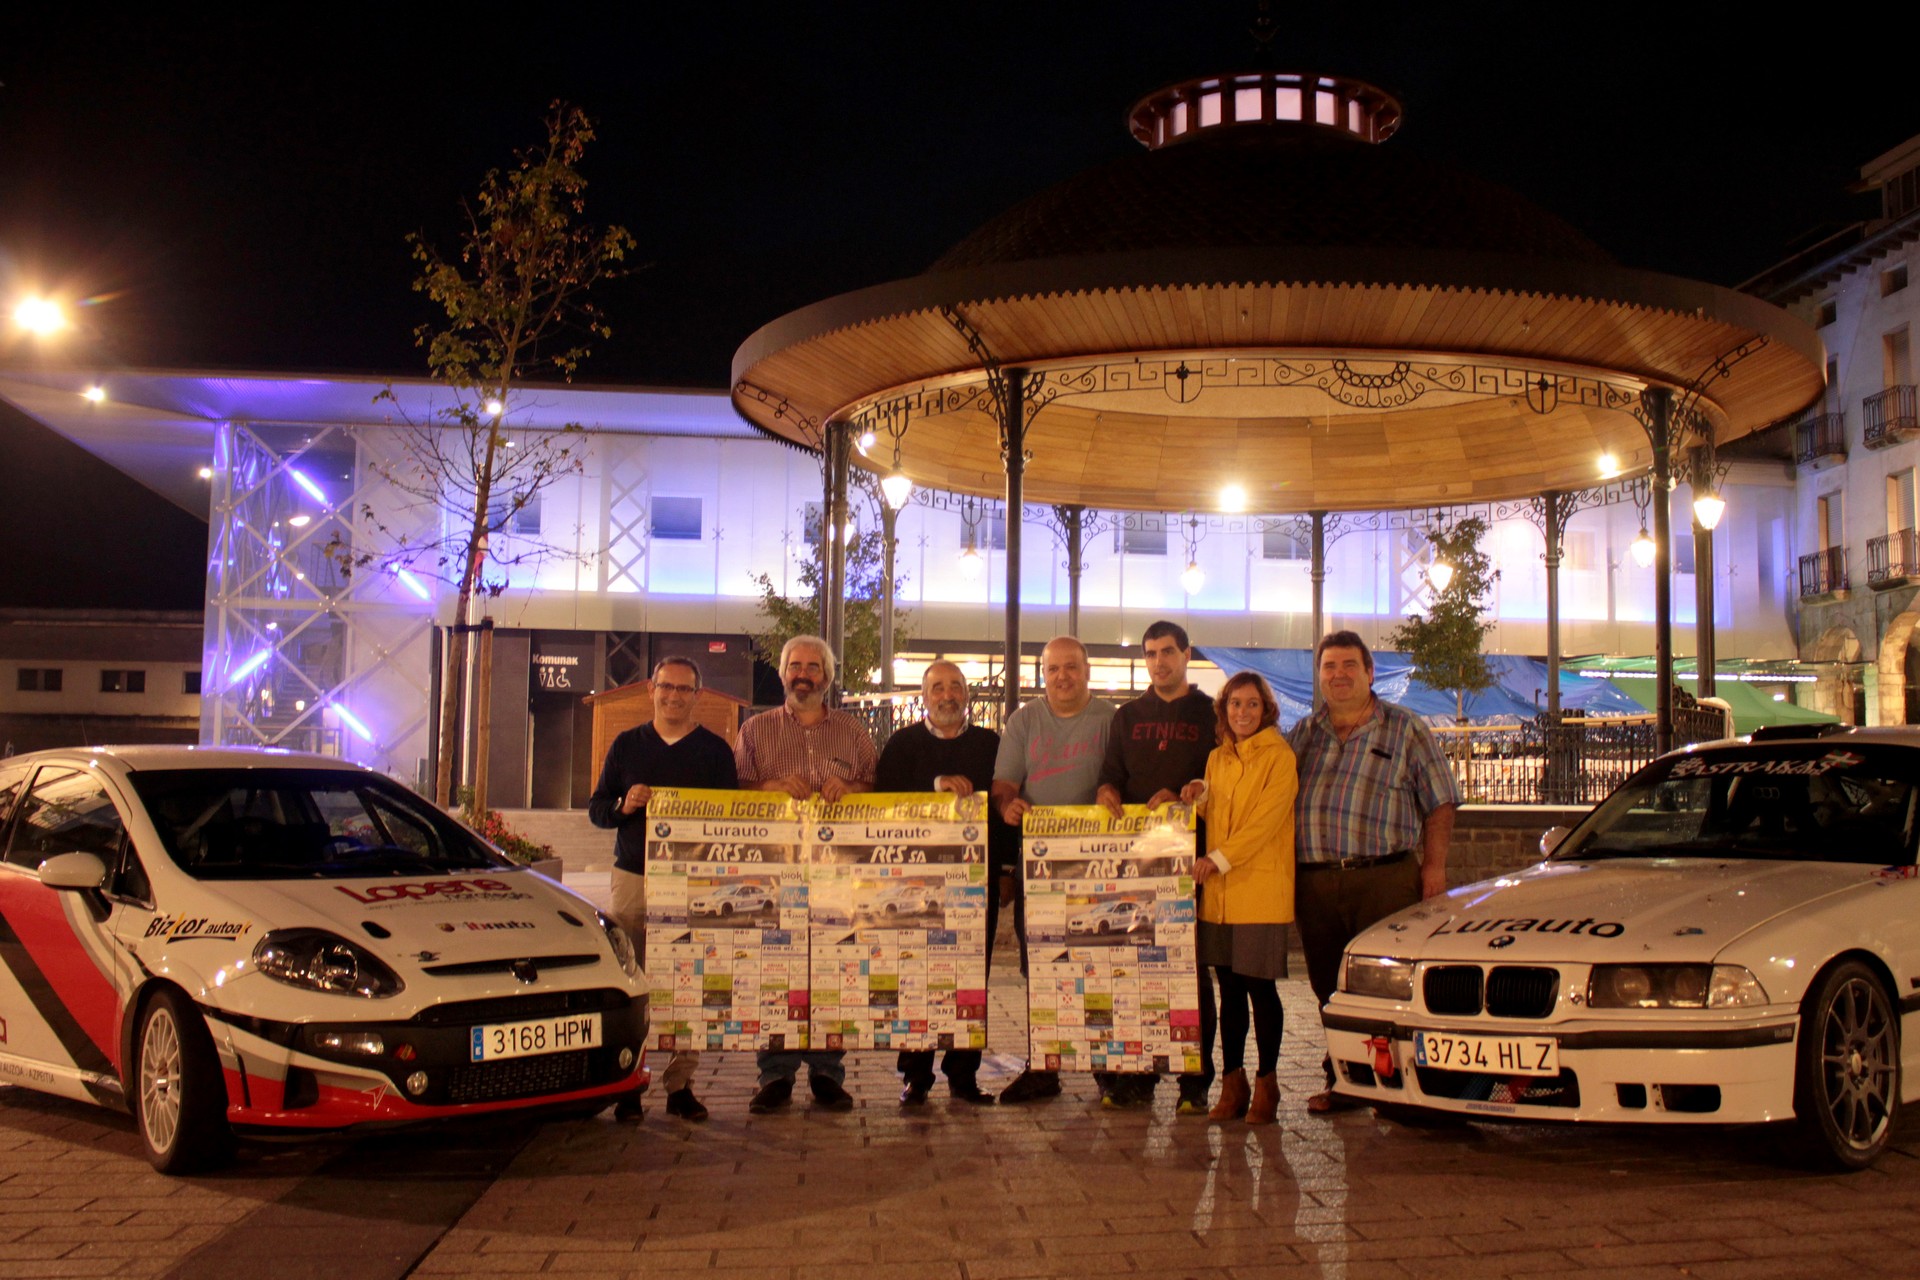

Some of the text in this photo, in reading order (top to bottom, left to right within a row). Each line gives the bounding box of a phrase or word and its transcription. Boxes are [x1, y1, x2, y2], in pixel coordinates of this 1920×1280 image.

[533, 654, 578, 665] Komunak
[1132, 722, 1199, 742] ETNIES
[730, 800, 787, 817] IGOERA
[703, 823, 768, 838] Lurauto
[866, 826, 931, 839] Lurauto
[745, 850, 763, 862] SA
[908, 850, 927, 863] SA
[1122, 865, 1139, 878] SA
[144, 912, 253, 938] Bizkor autoak
[1426, 917, 1625, 939] Lurauto
[493, 1025, 546, 1054] 3168
[554, 1018, 592, 1048] HPW
[1427, 1037, 1488, 1067] 3734
[1499, 1042, 1553, 1071] HLZ
